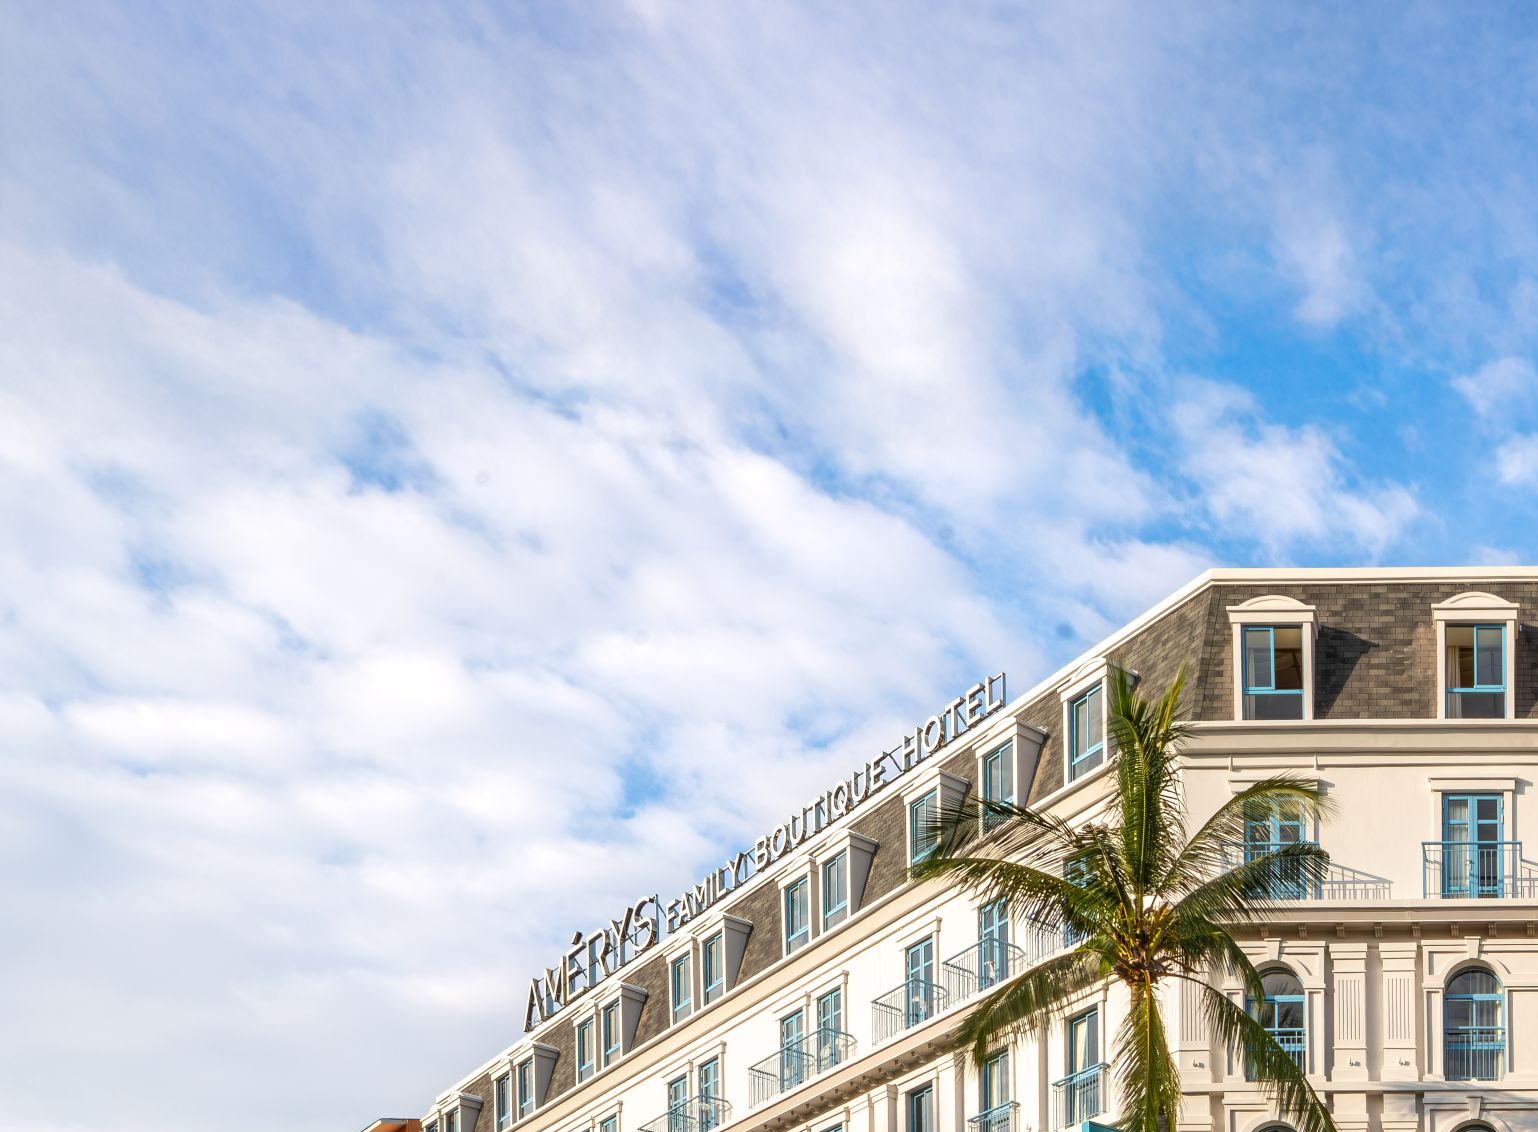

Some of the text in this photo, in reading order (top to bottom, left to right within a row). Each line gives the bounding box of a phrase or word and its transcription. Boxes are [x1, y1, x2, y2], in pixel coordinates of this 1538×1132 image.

[523, 674, 1005, 1032] AMÉRYS FAMILY BOUTIQUE HOTEL
